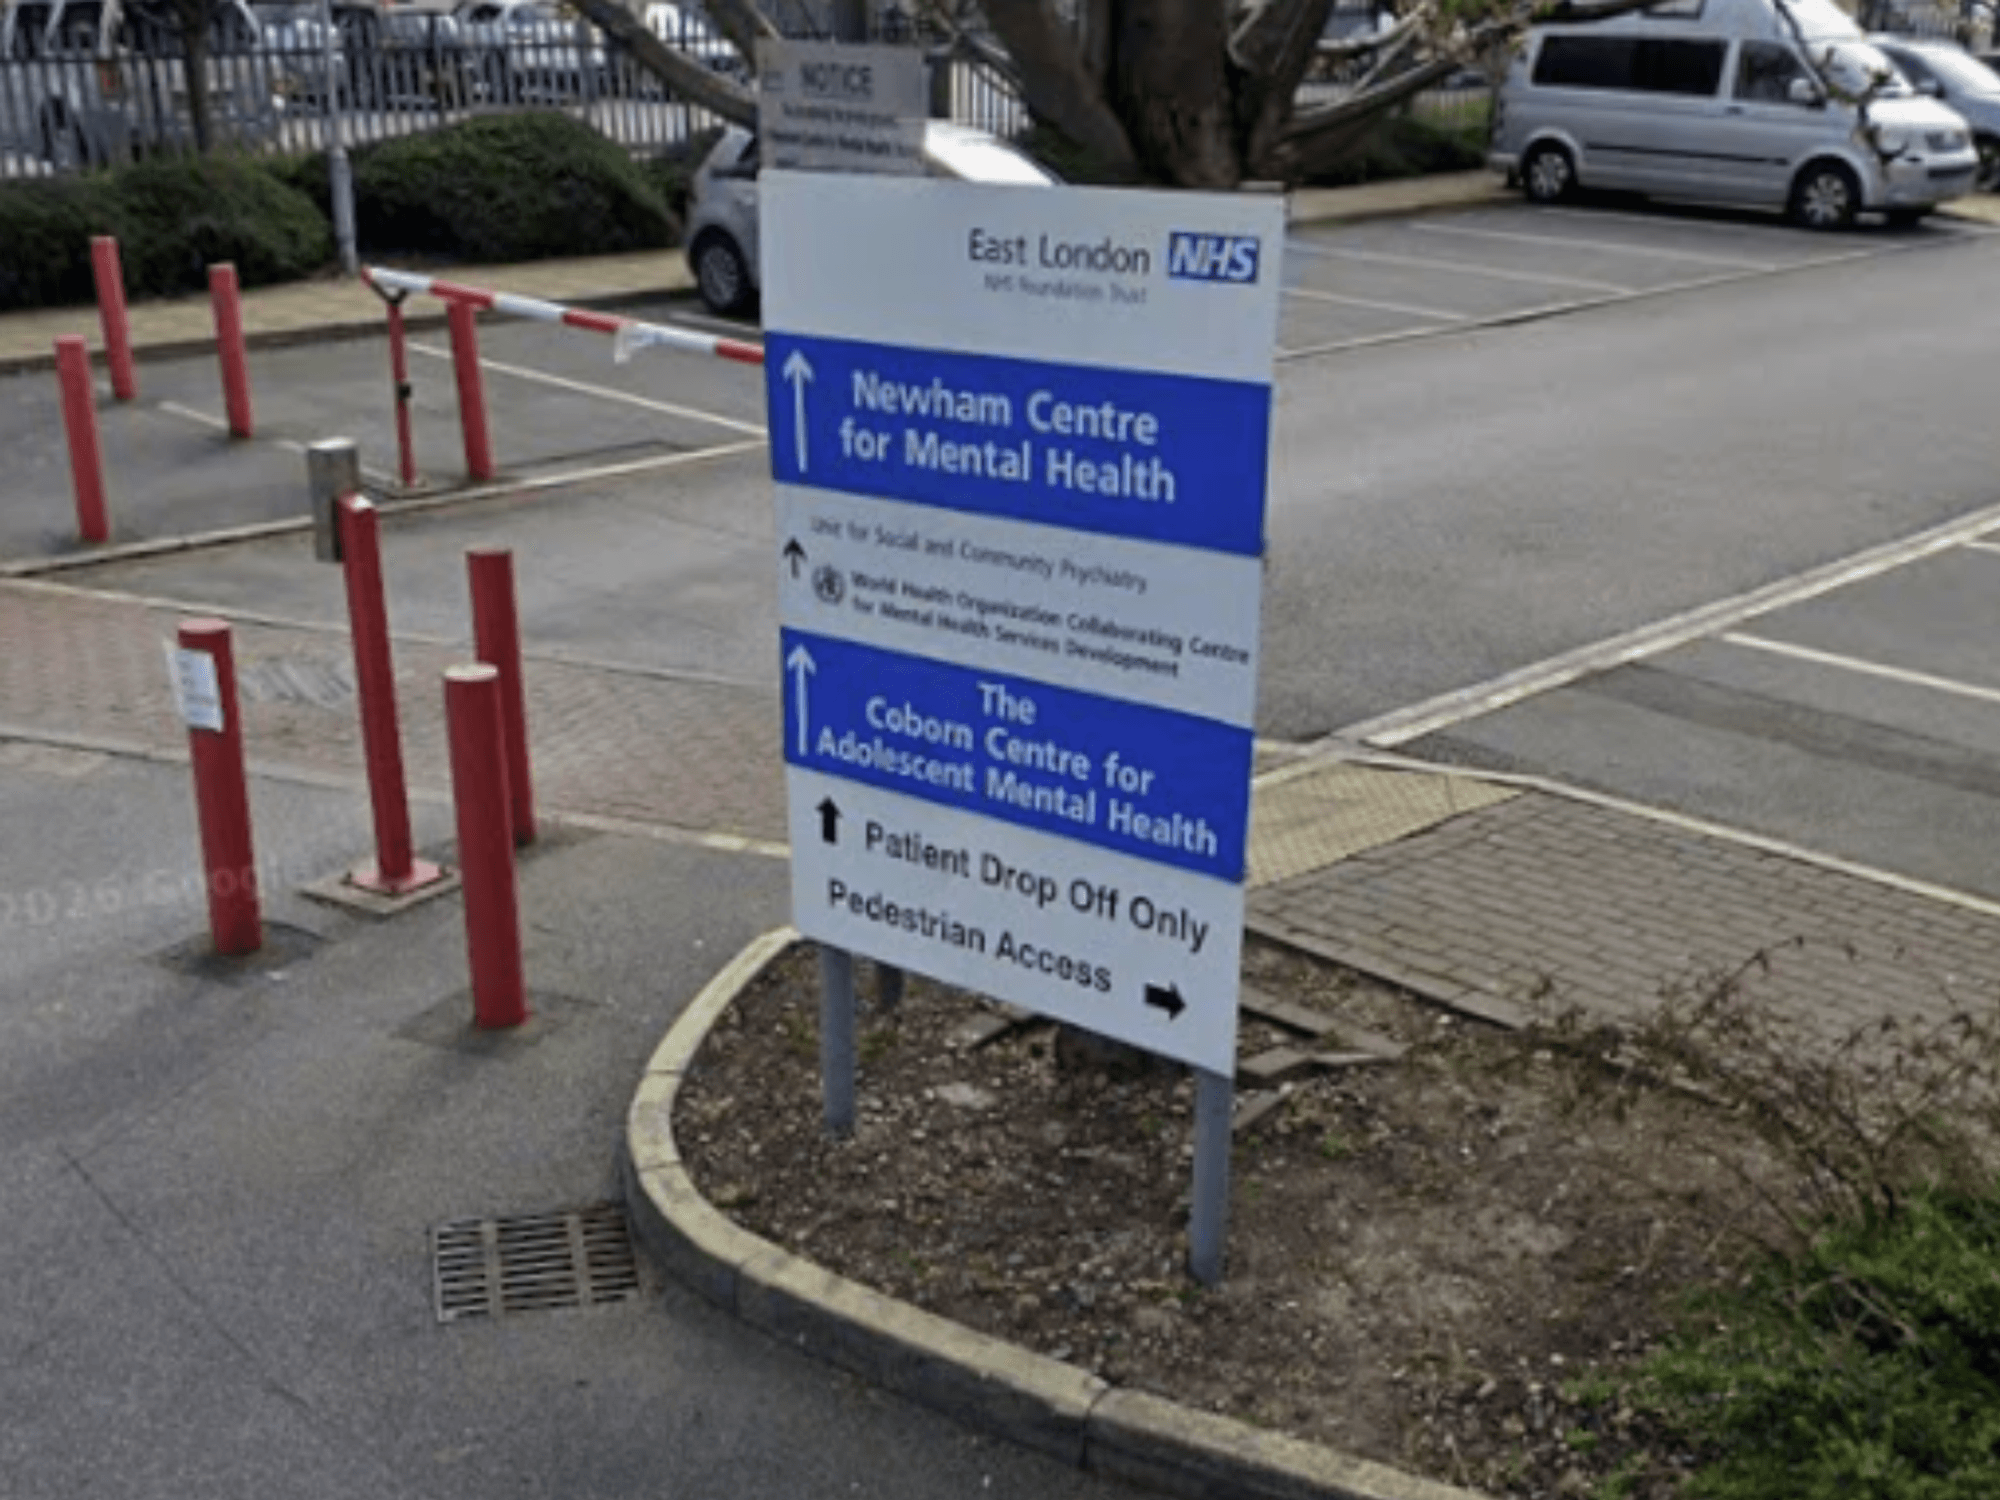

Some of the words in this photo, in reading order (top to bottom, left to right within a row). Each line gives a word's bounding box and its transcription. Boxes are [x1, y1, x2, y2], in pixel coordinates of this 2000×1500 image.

[968, 227, 1027, 266] East
[1038, 232, 1151, 274] London
[1170, 233, 1258, 282] NHS
[851, 369, 1013, 428] Newham
[1026, 389, 1159, 446] Centre
[838, 416, 891, 462] for
[904, 427, 1032, 482] Mental
[1046, 447, 1176, 504] Health
[847, 518, 869, 542] for
[874, 522, 919, 551] Social
[924, 537, 954, 558] and
[960, 538, 1054, 582] Community
[851, 569, 897, 596] World
[902, 579, 953, 606] Health
[1066, 612, 1183, 658] Collaborating
[1188, 635, 1250, 667] Centre
[852, 594, 876, 615] for
[879, 601, 935, 628] Mental
[936, 612, 991, 640] Health
[995, 623, 1061, 656] Services
[1065, 636, 1180, 680] Development
[864, 695, 975, 752] Coborn
[984, 726, 1092, 782] Centre
[1103, 750, 1157, 797] for
[976, 681, 1038, 726] The
[815, 725, 976, 793] Adolescent
[985, 767, 1097, 826] Mental
[1108, 798, 1218, 859] Health
[865, 820, 971, 879] Patient
[980, 852, 1058, 909] Drop
[1069, 878, 1119, 921] Off
[1128, 895, 1210, 954] Only
[827, 877, 986, 954] Pedestrian
[995, 930, 1113, 993] Access
